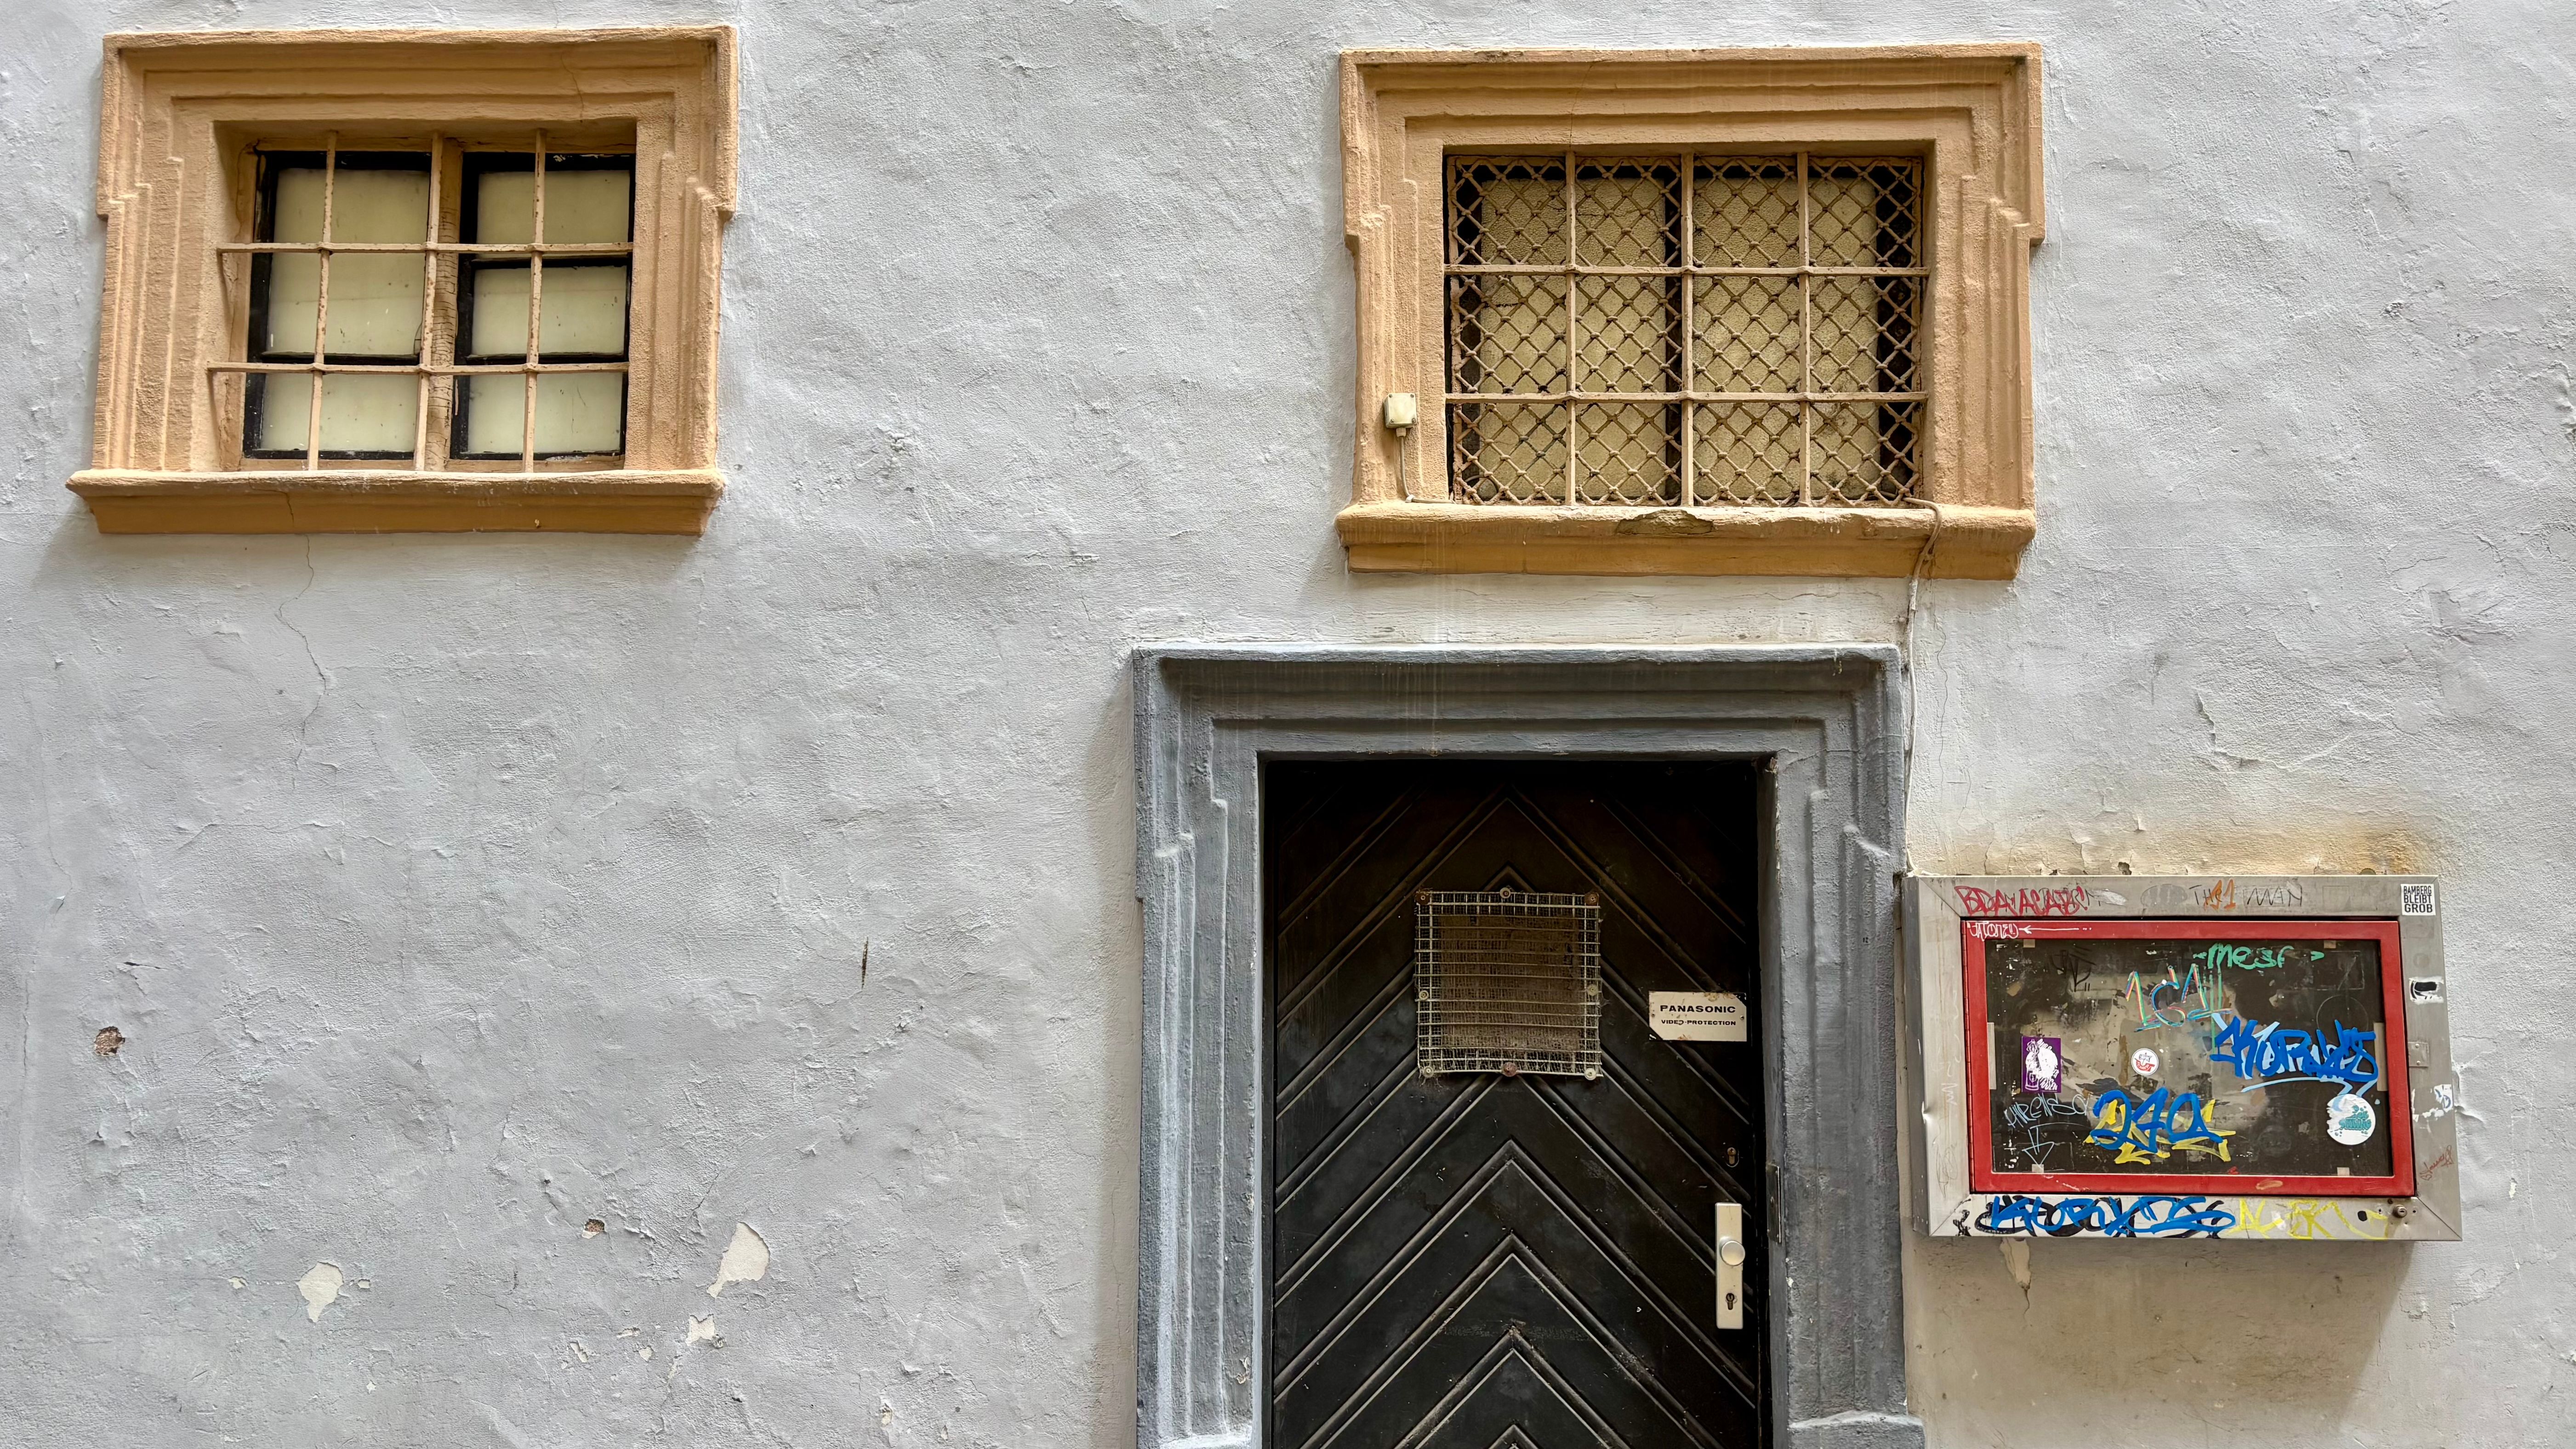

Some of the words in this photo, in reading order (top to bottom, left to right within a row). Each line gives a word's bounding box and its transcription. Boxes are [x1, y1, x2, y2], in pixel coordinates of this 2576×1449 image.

[2404, 885, 2432, 895] BAMBERG
[2404, 895, 2432, 903] BLEIBT
[2405, 904, 2433, 913] GROB
